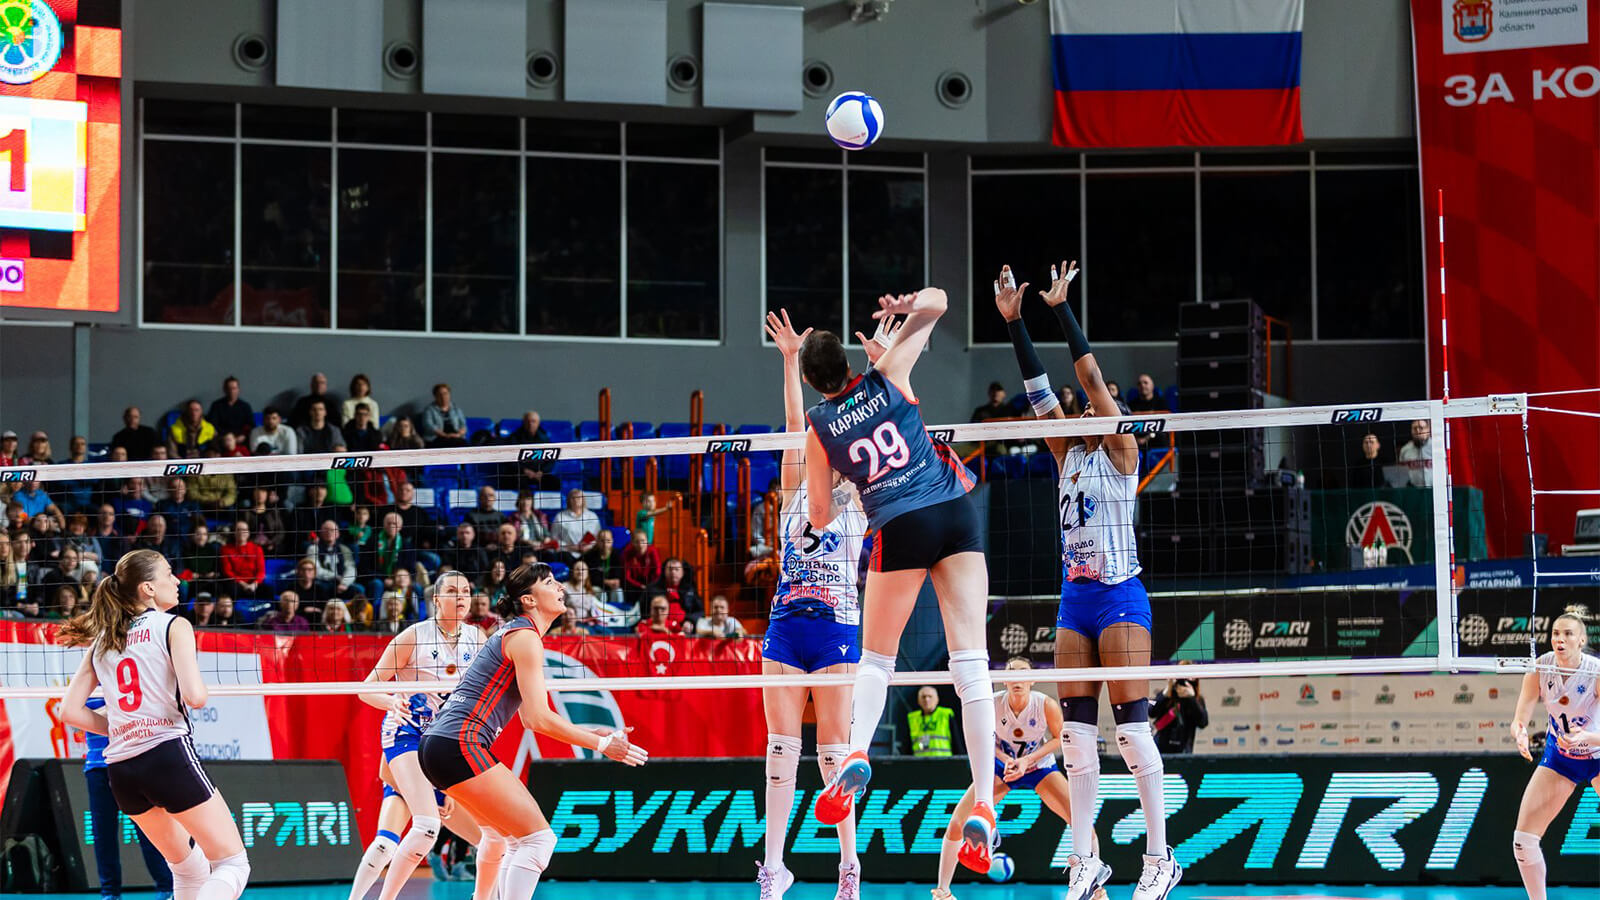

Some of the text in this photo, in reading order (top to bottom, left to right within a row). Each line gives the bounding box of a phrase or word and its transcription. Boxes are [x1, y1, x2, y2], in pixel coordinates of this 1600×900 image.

[1499, 4, 1578, 18] Калининградской
[1499, 22, 1535, 33] области
[1444, 72, 1515, 107] ЗА
[0, 129, 27, 192] 1
[837, 390, 867, 414] PARI
[828, 392, 888, 437] КАРАКУРТ
[1335, 408, 1381, 423] PARI
[1120, 420, 1164, 433] PARI
[709, 440, 748, 453] PARI
[849, 421, 910, 484] 29
[521, 449, 559, 460] PARI
[166, 464, 201, 476] PARI
[333, 456, 371, 469] PARI
[2, 470, 35, 482] PARI
[1060, 491, 1085, 530] 21
[807, 570, 841, 583] Барс
[1260, 621, 1311, 636] PARI
[1497, 616, 1550, 632] PARI
[116, 657, 143, 712] 9
[1559, 713, 1570, 733] 1
[1012, 740, 1027, 758] 7
[242, 802, 351, 848] PARI
